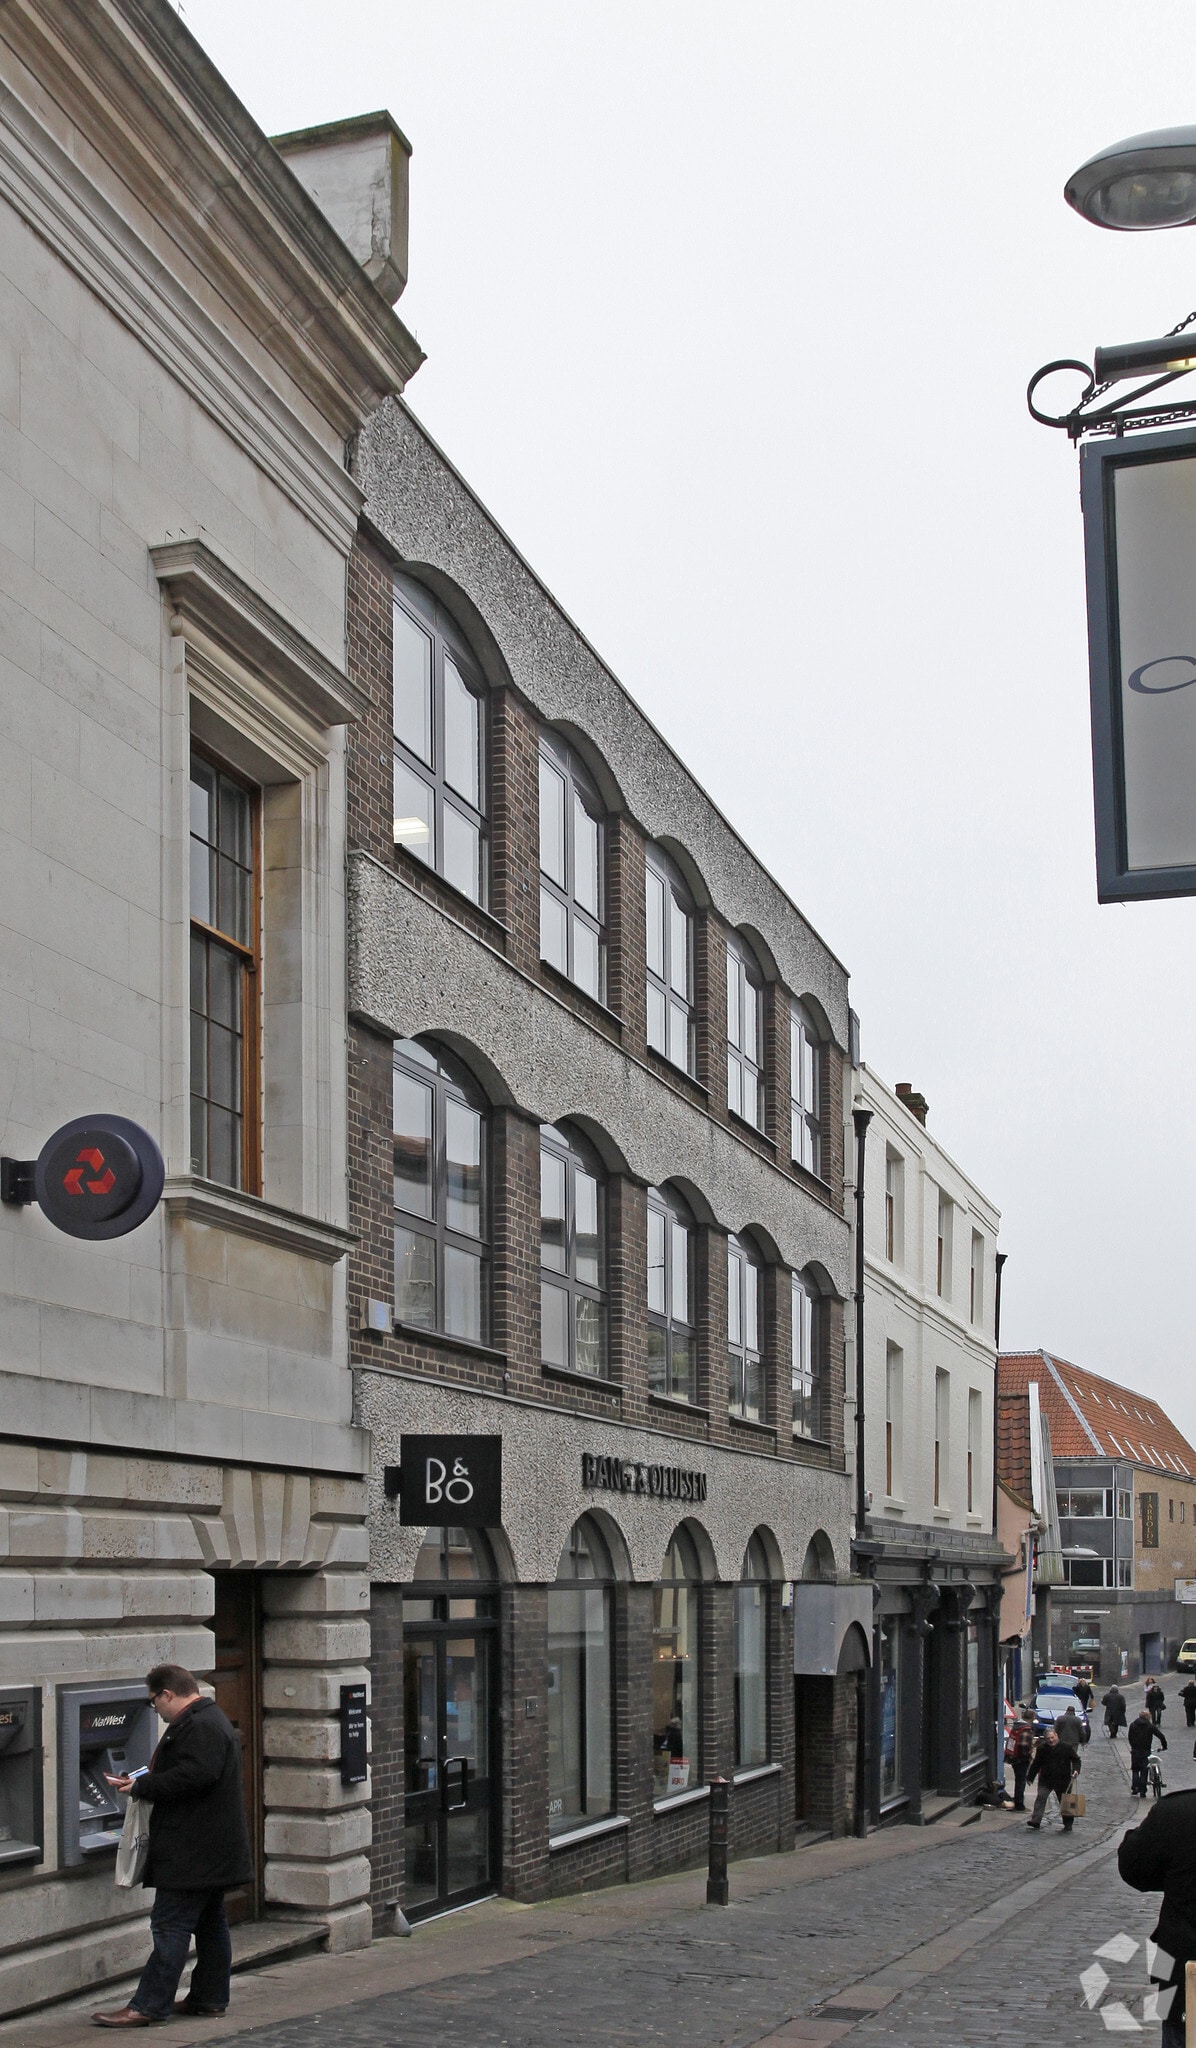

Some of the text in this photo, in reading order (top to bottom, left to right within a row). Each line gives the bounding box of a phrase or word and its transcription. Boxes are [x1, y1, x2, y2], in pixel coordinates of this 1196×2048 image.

[582, 1453, 633, 1491] BANG
[1145, 1494, 1154, 1545] JARROLDS
[92, 1714, 126, 1728] NatWest
